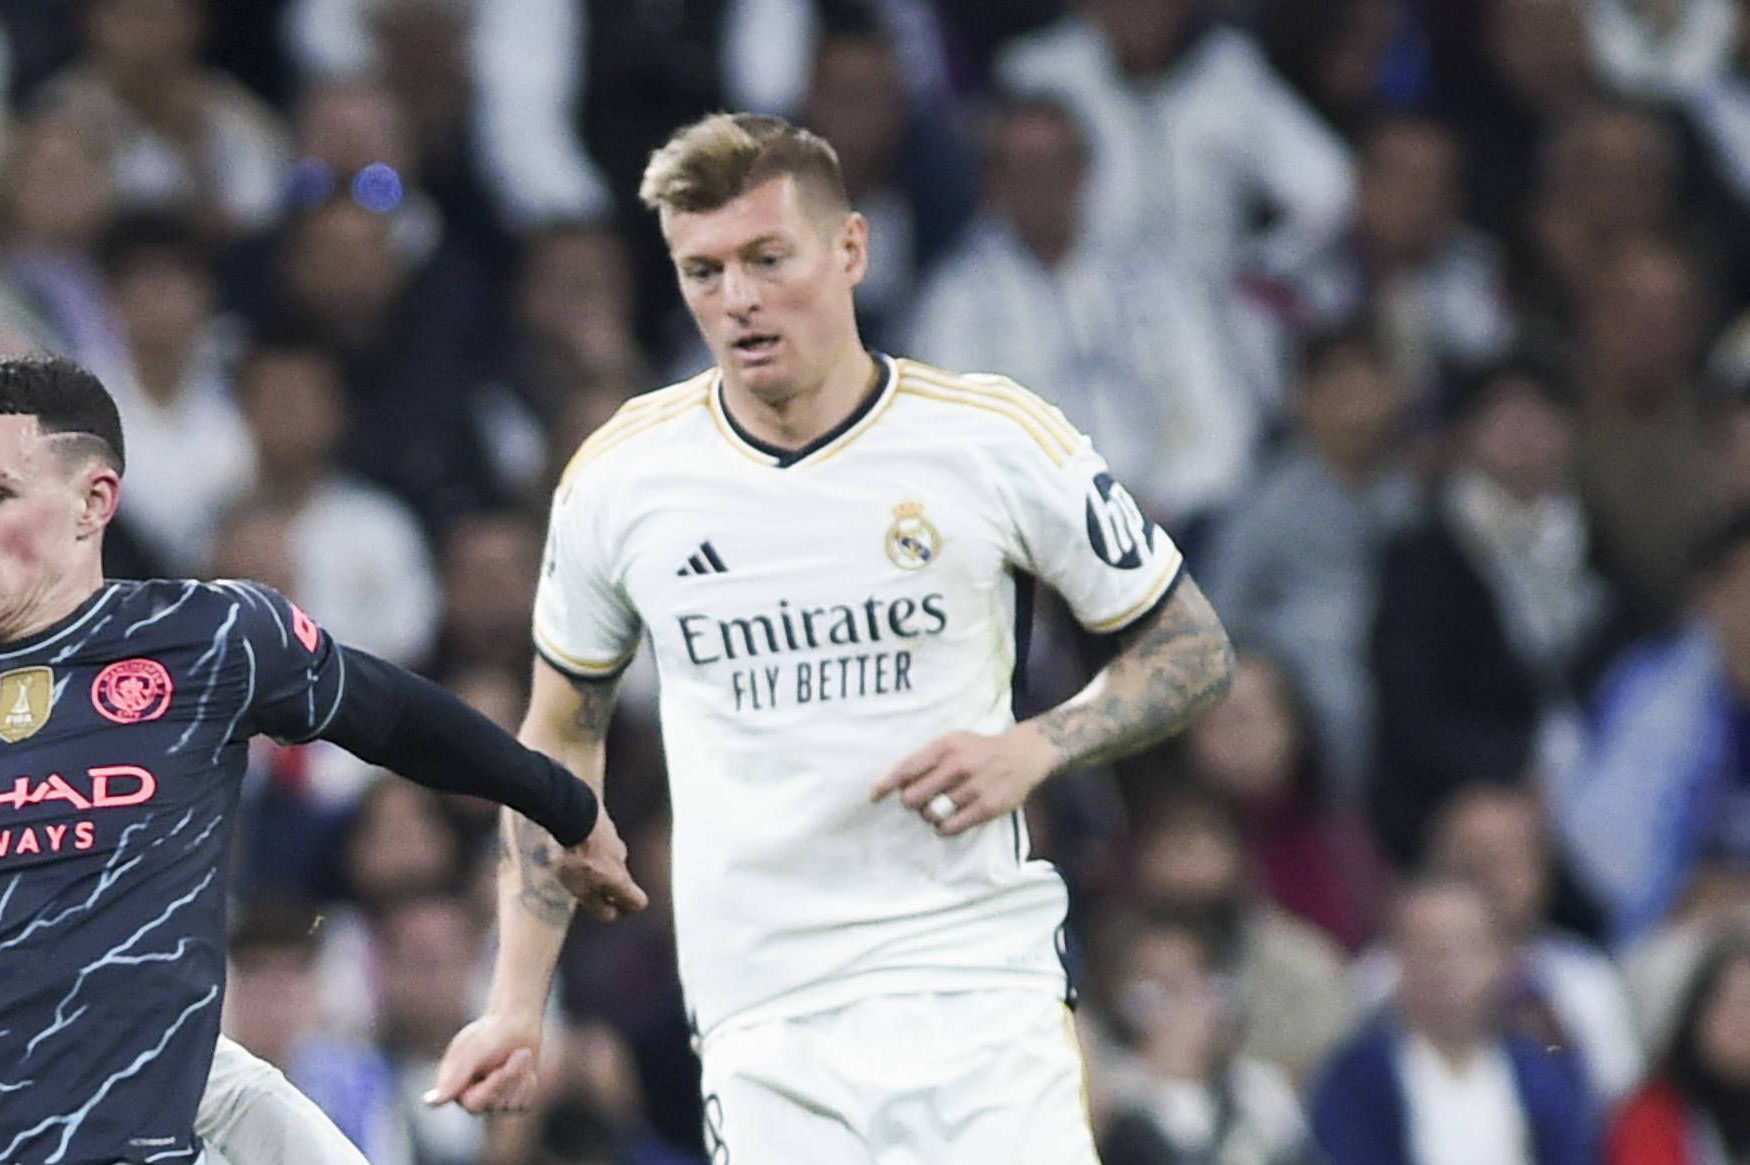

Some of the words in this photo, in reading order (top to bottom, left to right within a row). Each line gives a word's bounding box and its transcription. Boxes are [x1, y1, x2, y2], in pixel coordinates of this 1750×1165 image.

[677, 593, 948, 666] Emirates
[733, 665, 780, 711] FLY
[797, 649, 913, 704] BETTER
